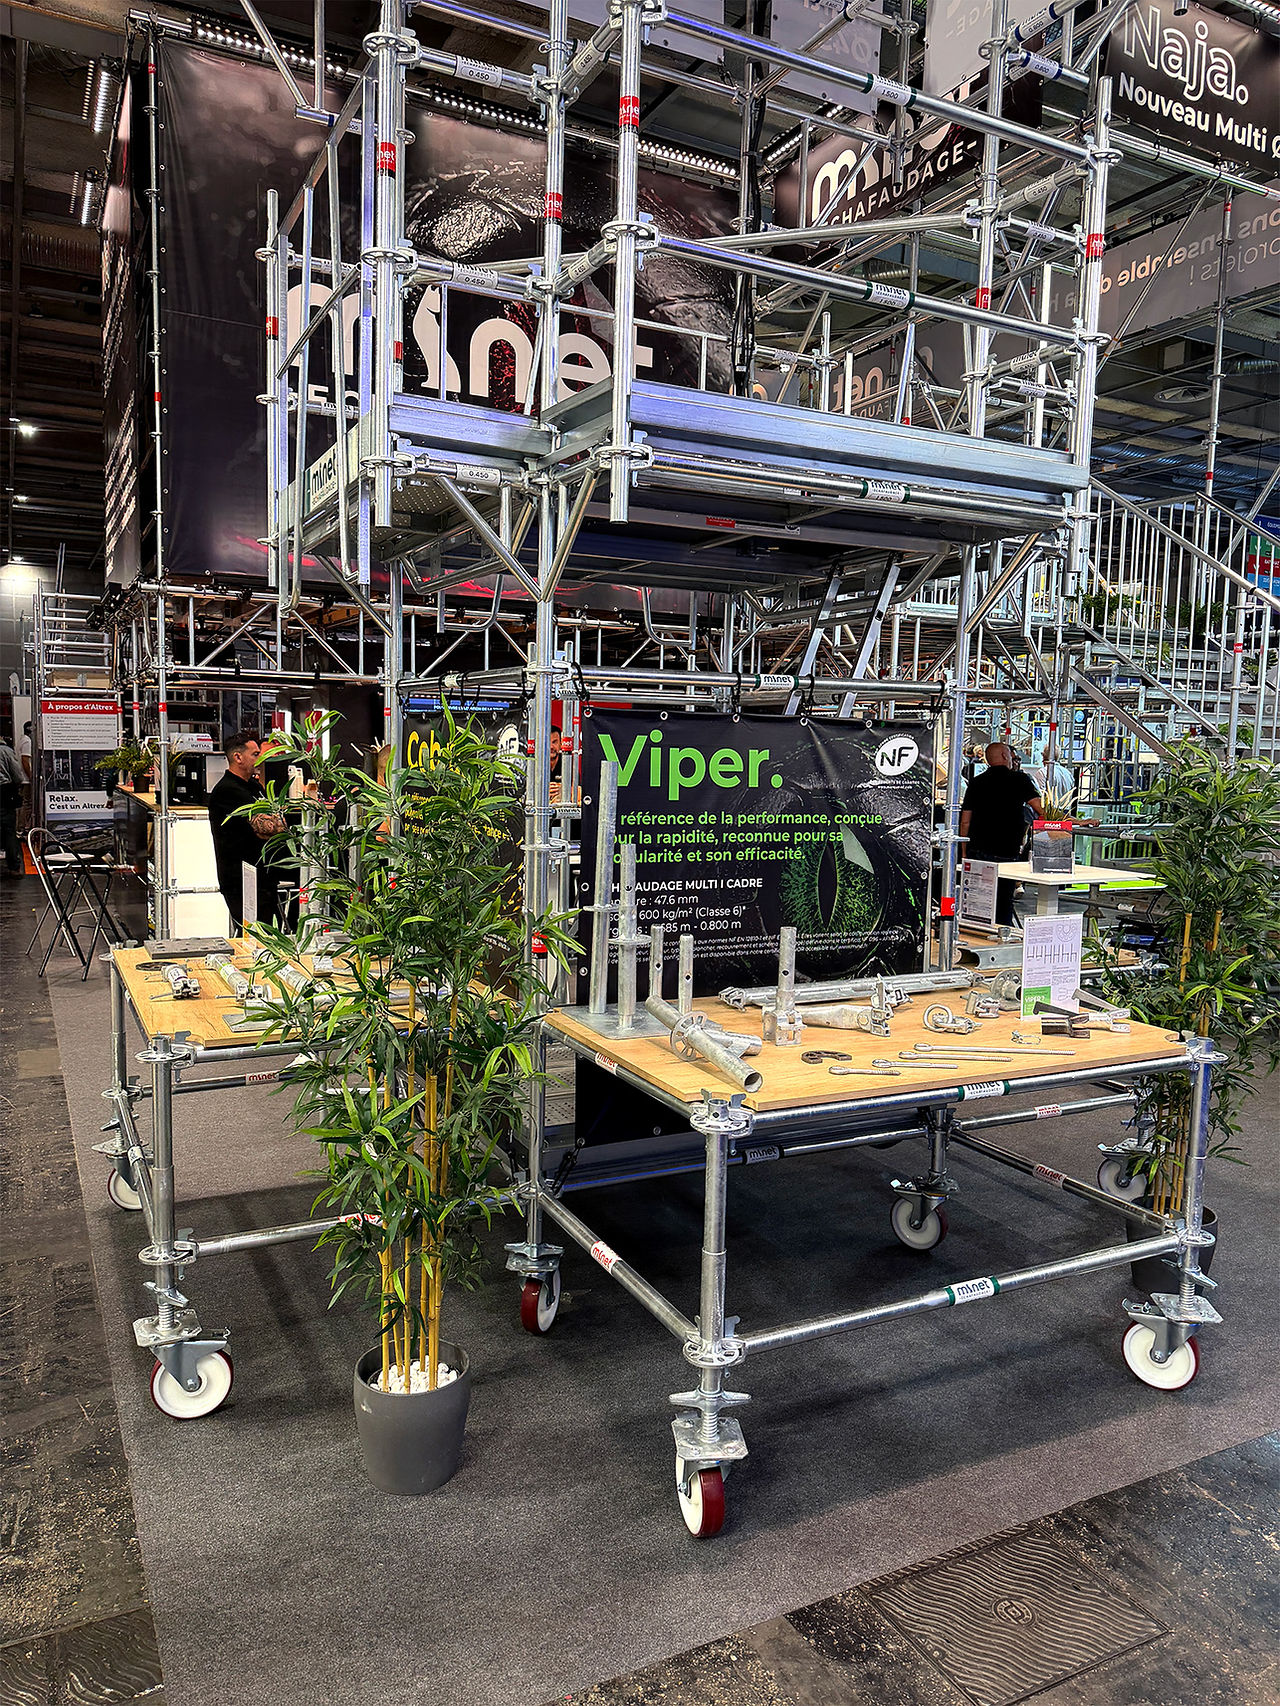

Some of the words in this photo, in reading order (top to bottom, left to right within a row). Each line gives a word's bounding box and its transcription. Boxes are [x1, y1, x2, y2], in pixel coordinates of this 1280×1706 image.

[1124, 3, 1249, 105] Naja.
[1119, 72, 1210, 133] Nouveau
[1215, 113, 1268, 153] Multi
[56, 703, 83, 711] propos
[84, 703, 114, 711] d'Altrex
[880, 746, 914, 767] NF
[597, 729, 783, 801] Viper.
[49, 795, 78, 803] Relax.
[620, 811, 694, 826] référence
[698, 811, 717, 825] de
[720, 811, 734, 825] la
[737, 811, 831, 827] performance,
[834, 814, 883, 828] conçue
[639, 831, 652, 844] la
[656, 830, 719, 846] rapidité,
[722, 831, 790, 843] reconnue
[794, 832, 826, 845] pour
[829, 831, 844, 842] sa
[687, 850, 702, 862] et
[705, 851, 732, 862] son
[735, 847, 806, 861] efficacité.
[685, 879, 718, 890] MULTI
[726, 878, 763, 889] CADRE
[654, 895, 676, 906] 47.6
[678, 895, 699, 904] mm
[639, 910, 660, 920] 600
[662, 907, 692, 921] kg/m²
[695, 908, 731, 919] (Classe
[680, 924, 691, 932] m
[700, 920, 729, 931] 0.800
[731, 921, 742, 930] m
[957, 1279, 991, 1296] minet
